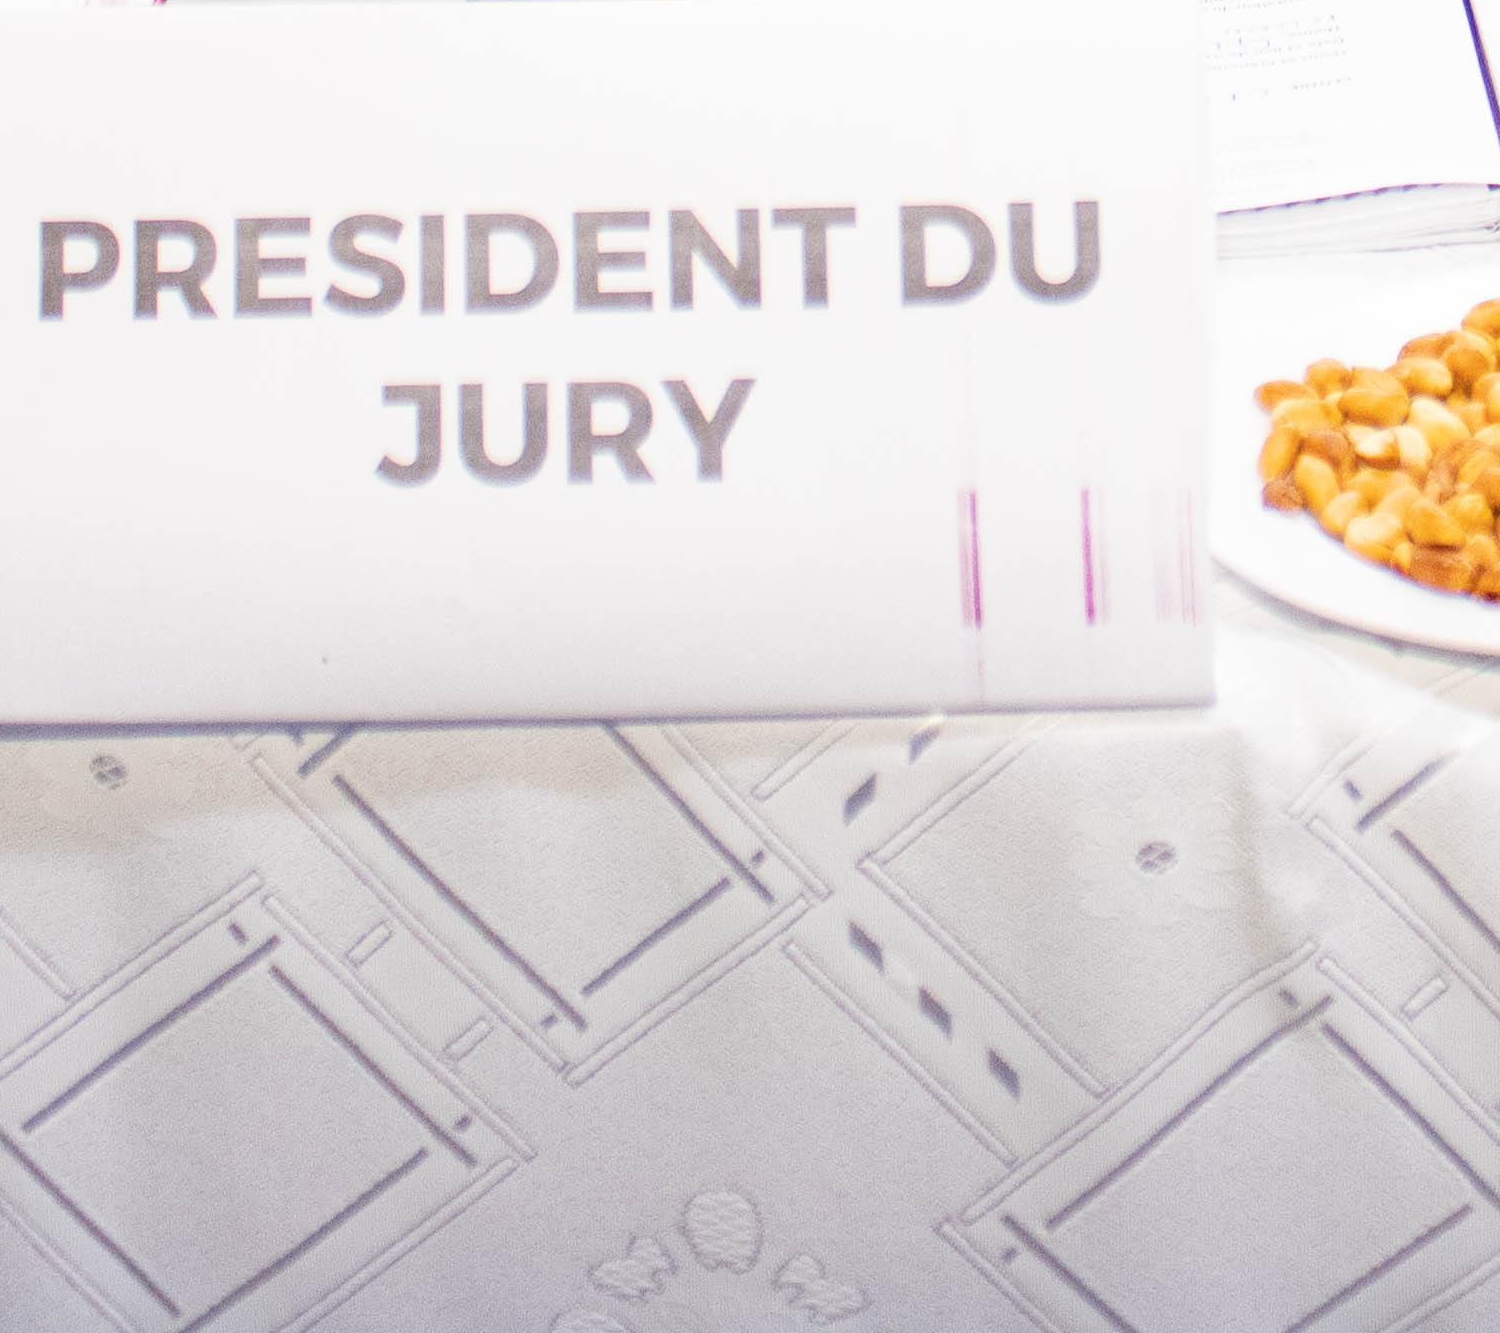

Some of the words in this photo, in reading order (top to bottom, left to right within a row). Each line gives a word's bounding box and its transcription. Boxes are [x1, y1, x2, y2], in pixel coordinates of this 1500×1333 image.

[37, 205, 856, 323] PRESIDENT
[898, 199, 1102, 311] DU
[373, 376, 757, 489] JURY
